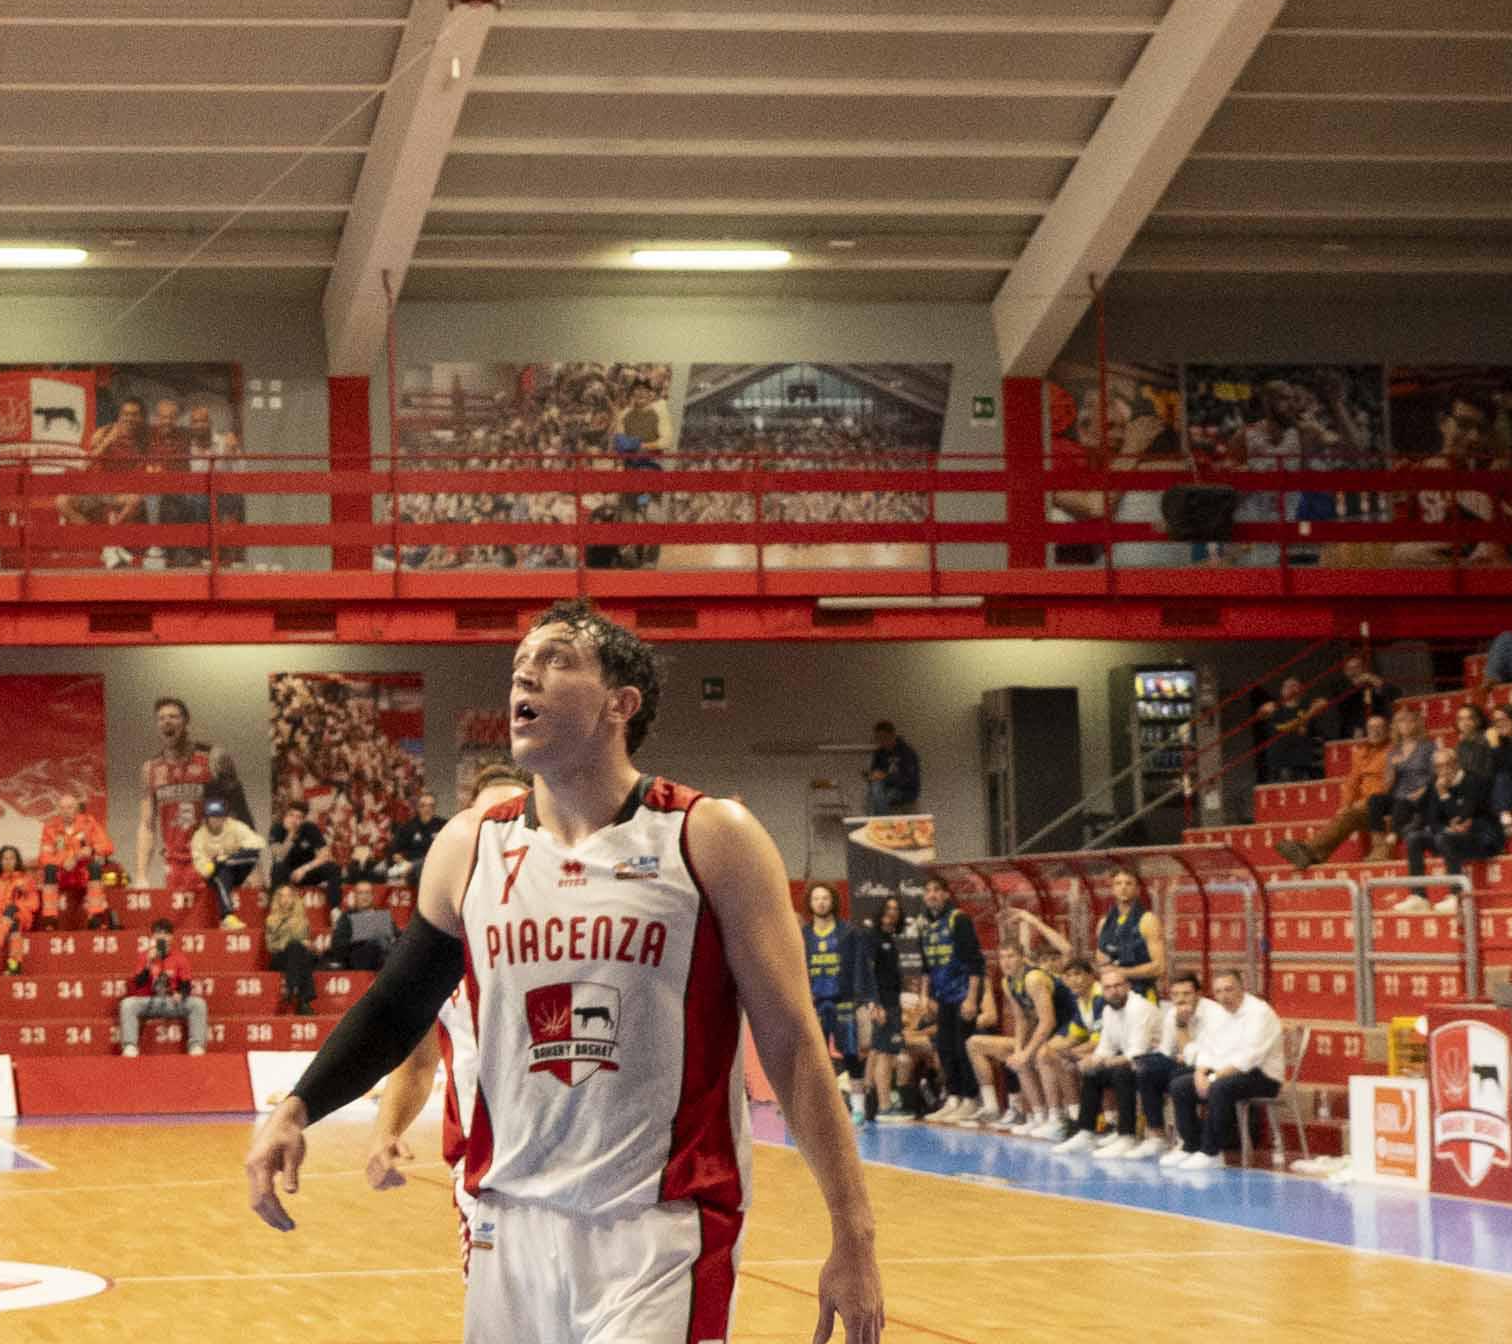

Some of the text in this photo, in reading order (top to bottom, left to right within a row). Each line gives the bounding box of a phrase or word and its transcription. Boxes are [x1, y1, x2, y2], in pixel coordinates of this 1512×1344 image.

[501, 845, 528, 904] 7
[128, 894, 151, 909] 36
[51, 938, 74, 953] 34
[94, 937, 117, 952] 35
[183, 935, 204, 951] 37
[227, 936, 250, 951] 38
[486, 916, 667, 968] PIACENZA
[13, 982, 37, 998] 33
[59, 982, 82, 998] 34
[237, 979, 261, 995] 38
[327, 978, 350, 993] 40
[21, 1027, 45, 1043] 33
[67, 1027, 91, 1043] 34
[157, 1026, 181, 1041] 36
[248, 1025, 272, 1041] 38
[292, 1024, 317, 1039] 39
